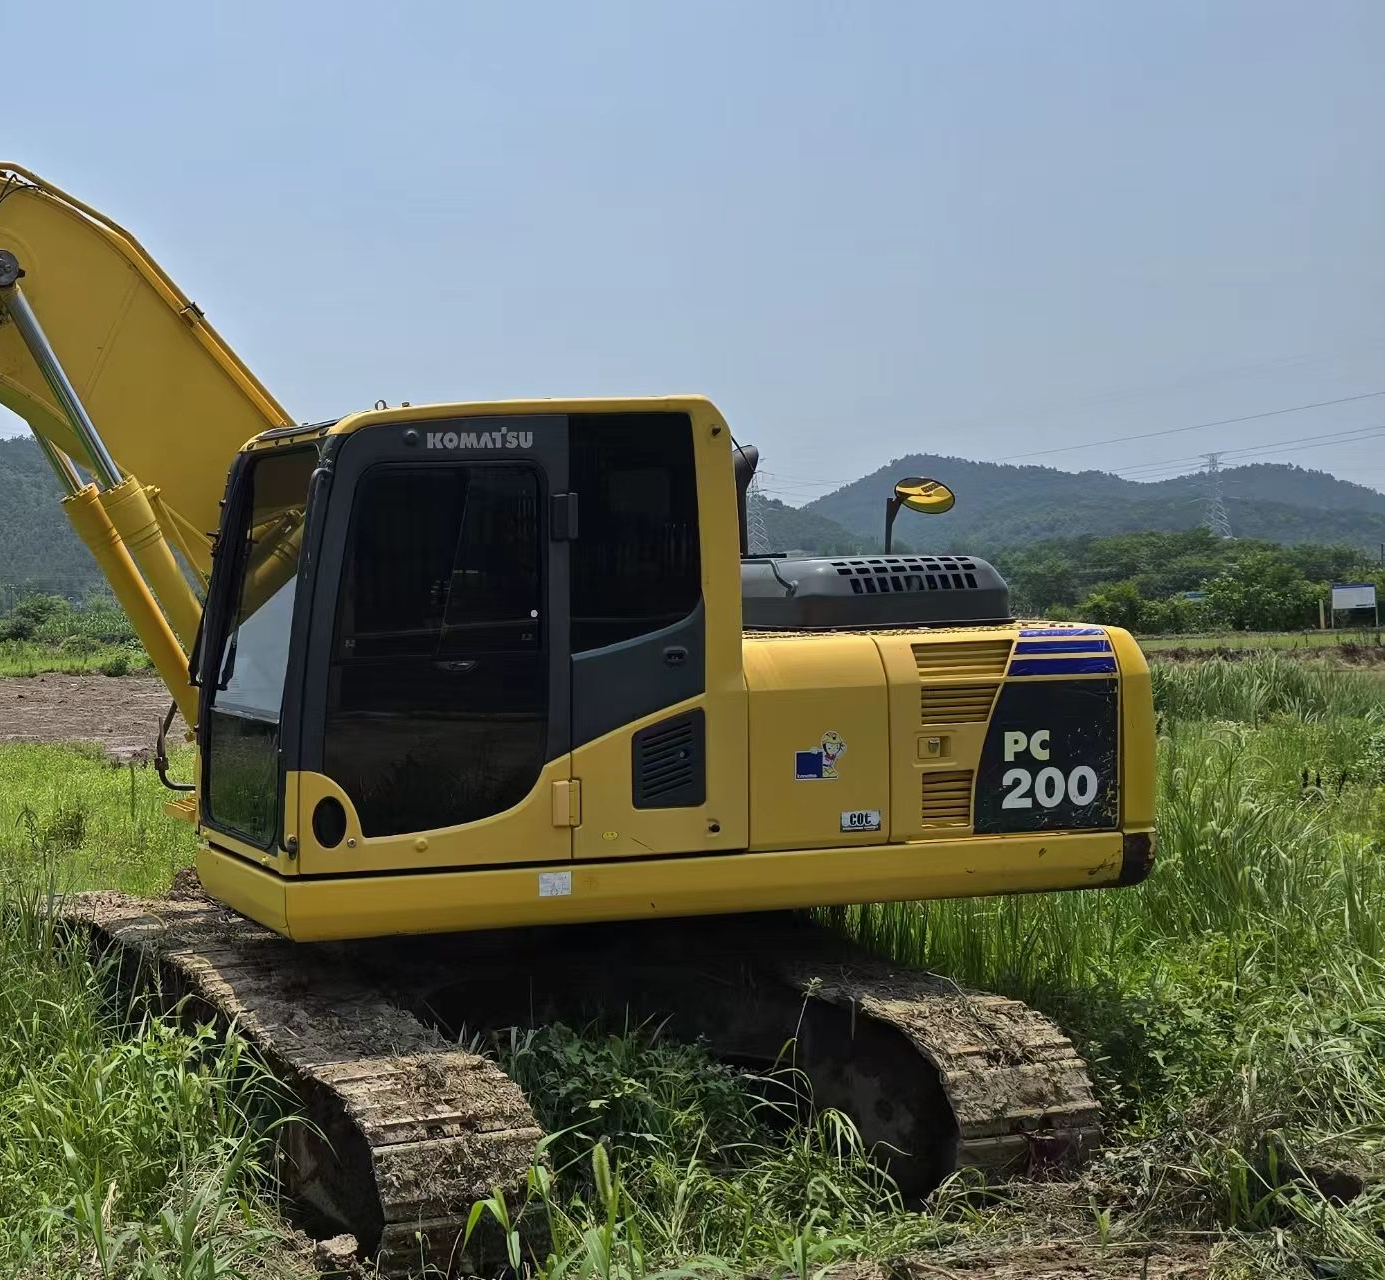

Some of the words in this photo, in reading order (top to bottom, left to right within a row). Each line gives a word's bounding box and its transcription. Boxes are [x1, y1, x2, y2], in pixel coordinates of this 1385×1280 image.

[426, 426, 534, 450] KOMATSU
[1004, 729, 1050, 762] PC
[1001, 765, 1098, 810] 200
